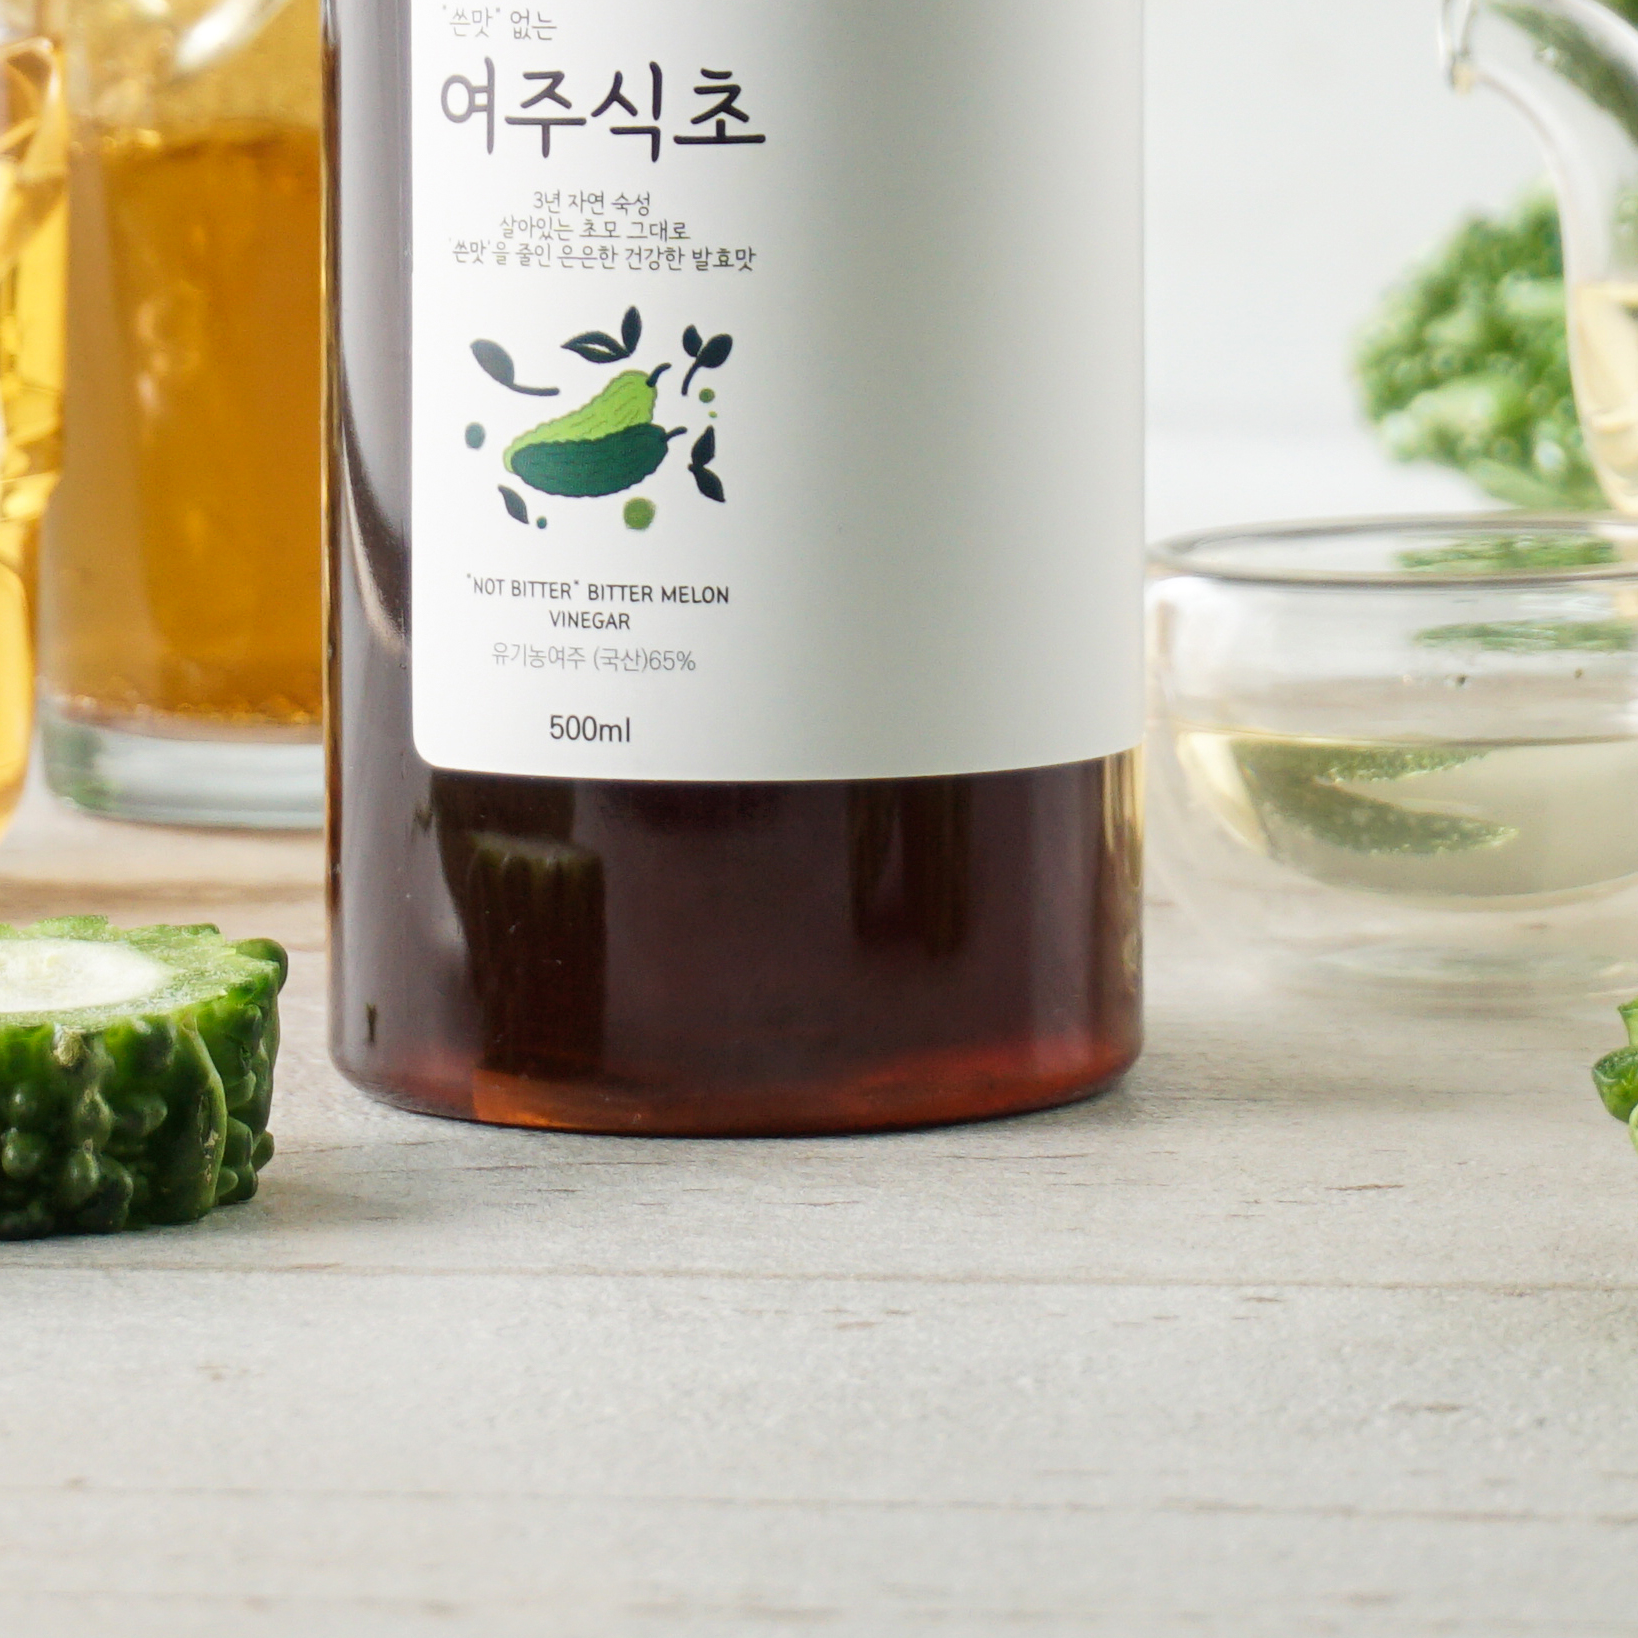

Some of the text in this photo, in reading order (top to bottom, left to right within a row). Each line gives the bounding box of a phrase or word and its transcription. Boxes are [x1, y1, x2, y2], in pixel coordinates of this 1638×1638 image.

[510, 7, 558, 41] 없는
[440, 56, 767, 163] 여주식초
[533, 189, 651, 216] 3년 자연 숙성
[500, 215, 574, 241] 살아있는
[626, 219, 691, 242] 그대로
[515, 243, 551, 267] 줄인
[556, 245, 619, 270] 은은한
[625, 245, 686, 271] 건강한
[691, 246, 757, 272] 발효맛
[587, 584, 654, 603] BITTER
[661, 585, 729, 605] MELON
[548, 610, 631, 630] VINEGAR
[491, 642, 586, 670] 유기농여주
[549, 715, 631, 742] 500ml
